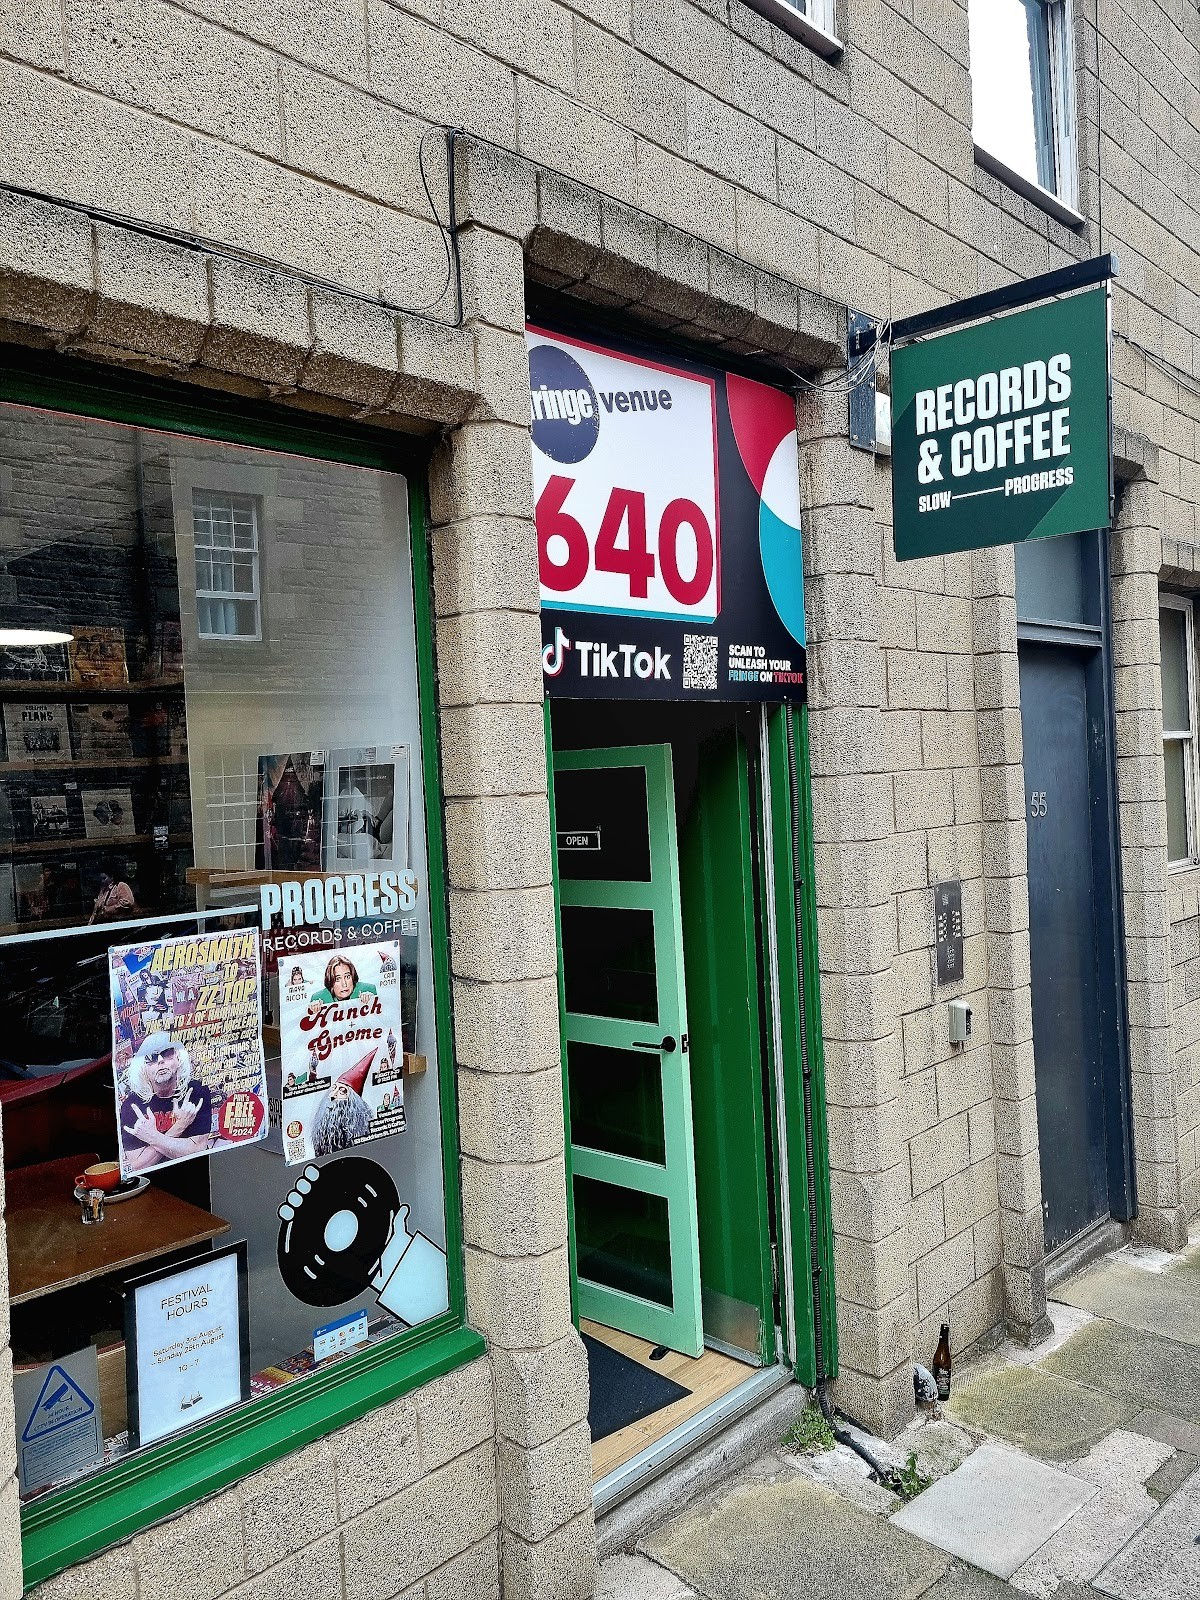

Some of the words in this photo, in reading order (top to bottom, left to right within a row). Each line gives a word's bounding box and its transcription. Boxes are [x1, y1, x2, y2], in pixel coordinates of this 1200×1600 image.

[599, 389, 673, 413] venue
[916, 353, 1072, 435] RECORDS
[917, 439, 944, 484] &
[951, 407, 1071, 477] COFFEE
[918, 491, 952, 513] SLOW
[1005, 466, 1074, 497] PROGRESS
[535, 474, 713, 606] 640
[575, 641, 672, 680] TikTok
[728, 644, 753, 657] SCAN
[753, 646, 766, 658] TO
[728, 657, 768, 671] UNLEASH
[768, 659, 792, 671] YOUR
[728, 669, 760, 682] FRINGE
[759, 671, 773, 683] ON
[773, 671, 804, 684] TIKTOK
[22, 711, 54, 722] PLANS
[1030, 791, 1048, 818] 55
[565, 835, 589, 846] OPEN
[260, 868, 417, 931] PROGRESS
[262, 928, 343, 952] RECORDS
[347, 926, 357, 940] &
[361, 917, 418, 938] COFFEE
[150, 934, 255, 974] AEROSMITH
[223, 962, 239, 982] TO
[195, 984, 219, 1012] ZZ
[222, 977, 257, 1005] TOP
[299, 996, 383, 1032] Hunch
[307, 1027, 383, 1061] Gnome
[232, 1127, 253, 1137] 2024
[161, 1283, 214, 1310] FESTIVAL
[167, 1298, 209, 1321] HOURS
[153, 1341, 185, 1357] Saturday
[185, 1336, 197, 1344] 3rd
[198, 1325, 223, 1339] August
[157, 1350, 183, 1364] Sunday
[200, 1332, 225, 1347] August
[178, 1364, 188, 1373] 10
